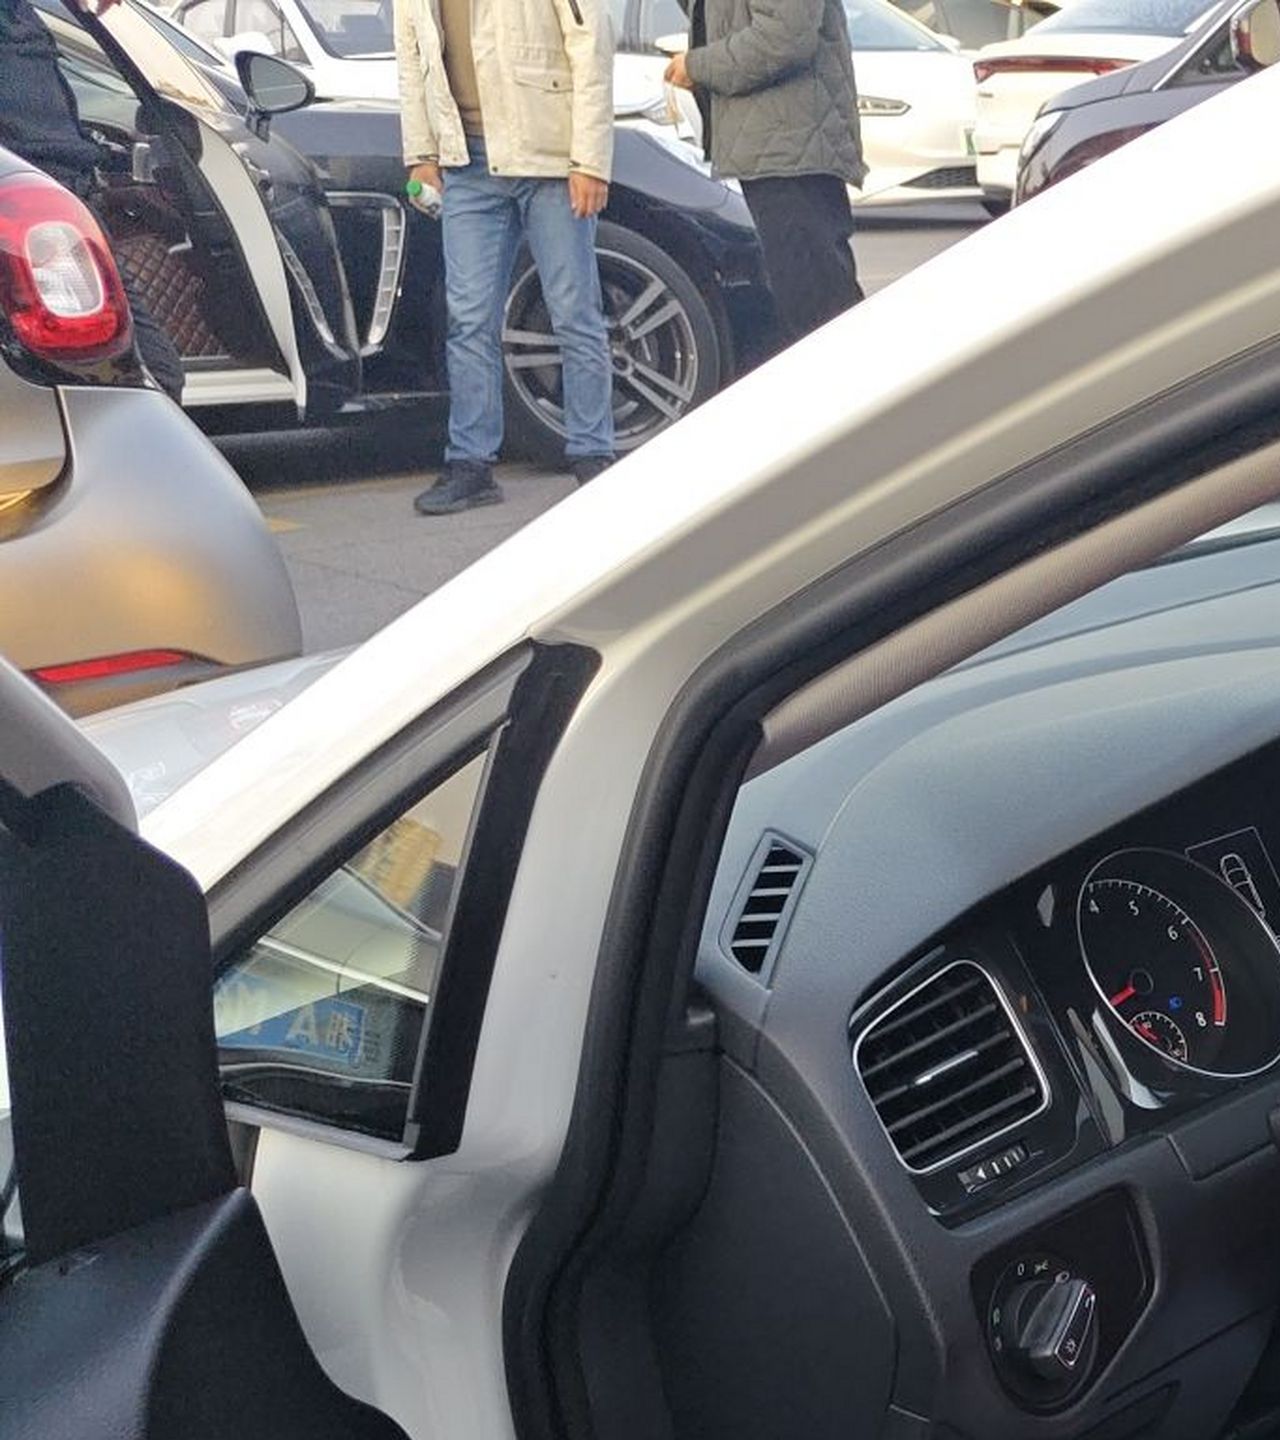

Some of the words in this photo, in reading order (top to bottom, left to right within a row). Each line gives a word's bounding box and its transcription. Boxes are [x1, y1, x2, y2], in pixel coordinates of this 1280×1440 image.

[1089, 899, 1100, 914] 4
[1129, 900, 1139, 916] 5
[1167, 925, 1178, 941] 6
[1193, 966, 1203, 982] 7
[1195, 1011, 1207, 1028] 8
